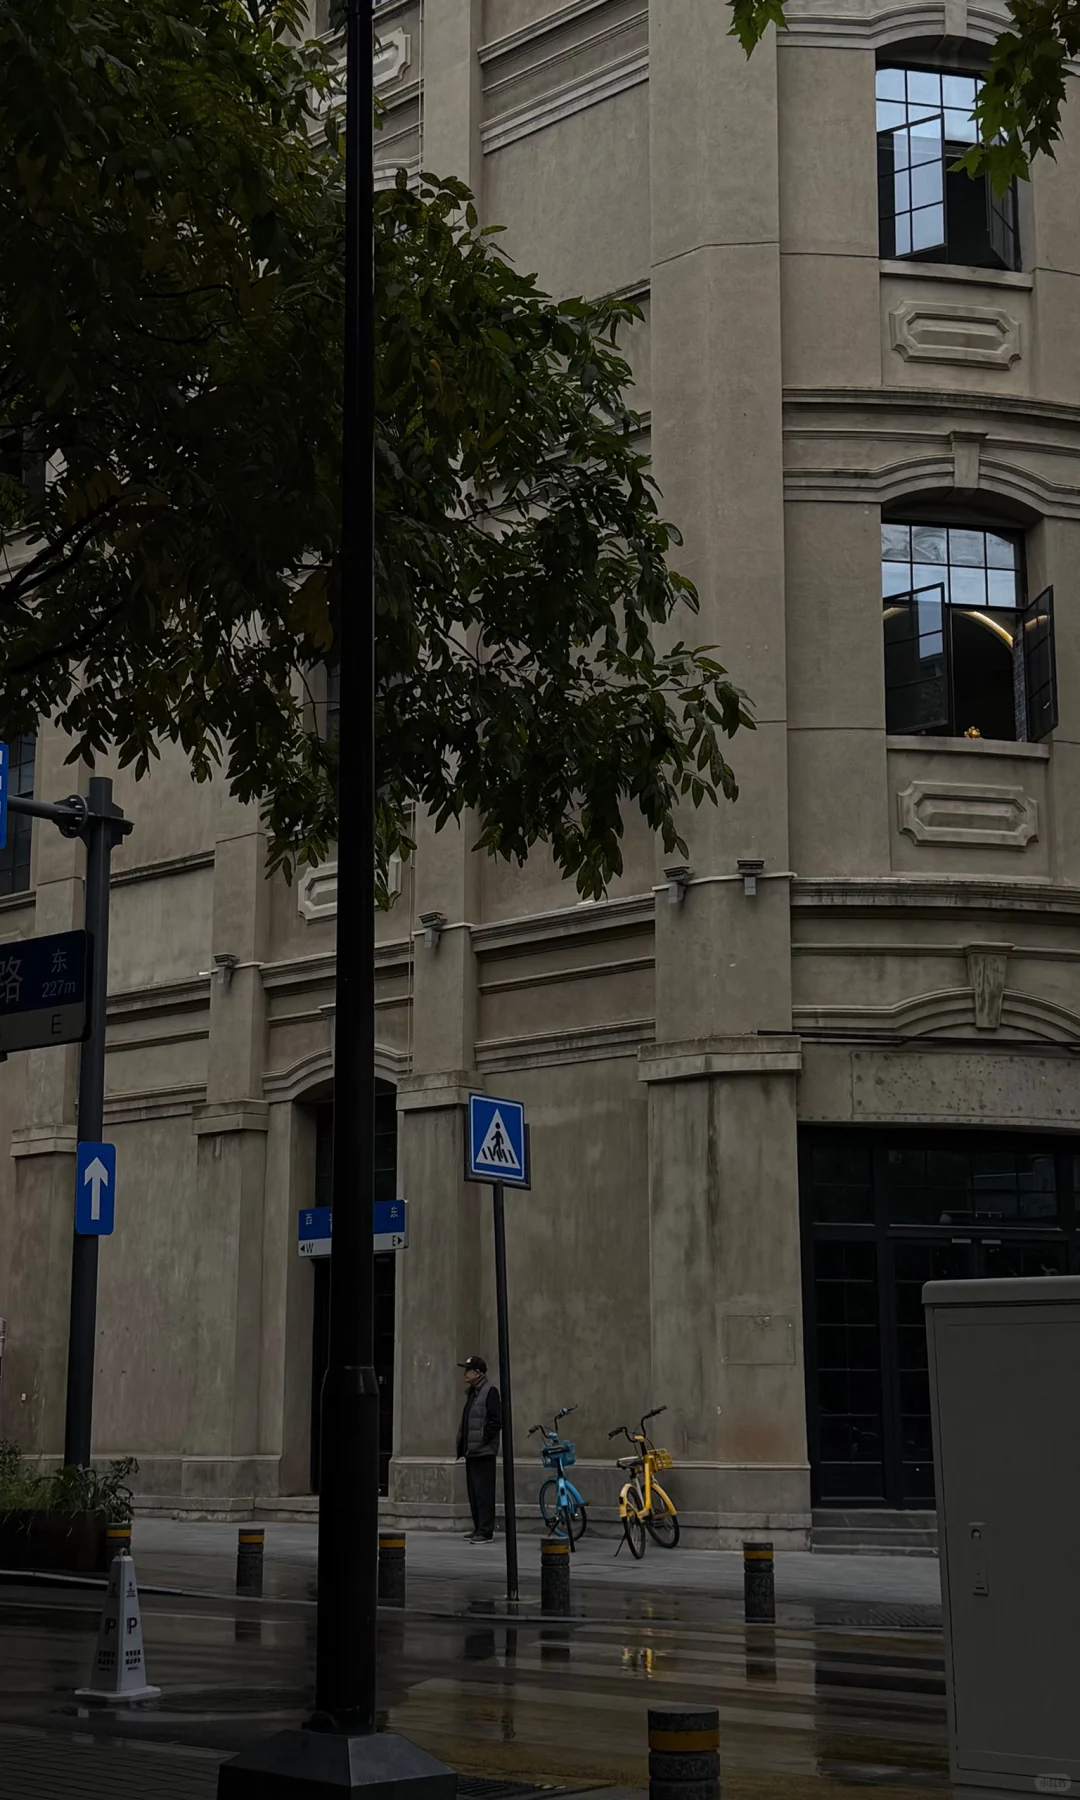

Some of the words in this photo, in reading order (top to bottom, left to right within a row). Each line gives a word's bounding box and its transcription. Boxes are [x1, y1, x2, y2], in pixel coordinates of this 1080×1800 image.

[51, 948, 68, 972] 东
[41, 980, 76, 998] 227m
[52, 1014, 61, 1034] E
[390, 1205, 399, 1218] 东
[306, 1242, 314, 1254] W
[391, 1235, 396, 1247] E
[127, 1617, 138, 1634] P
